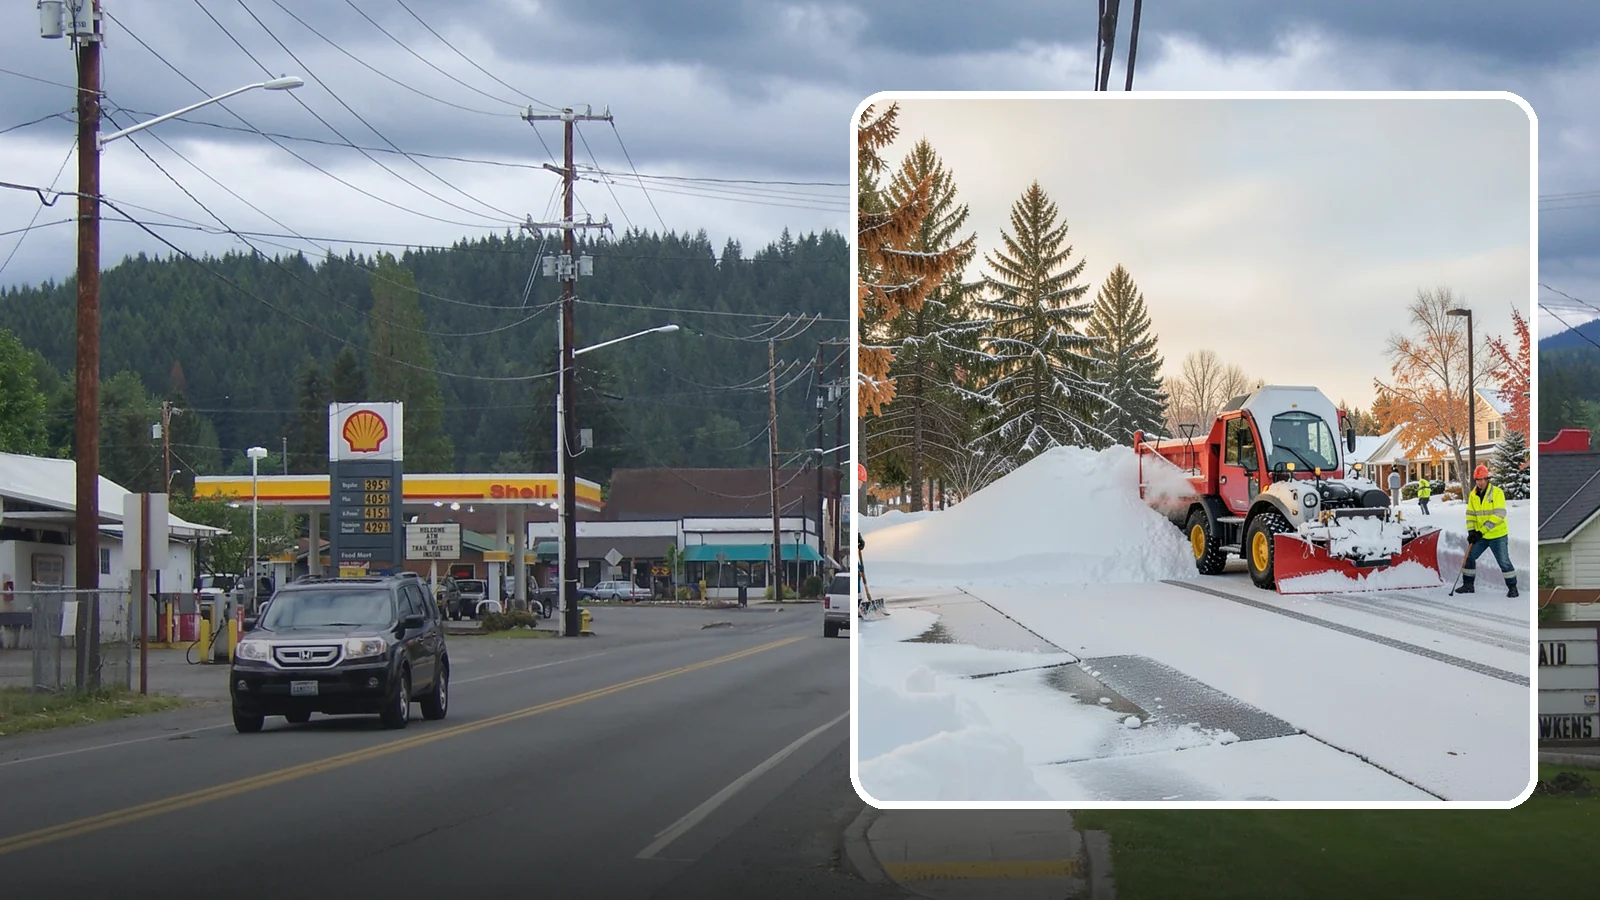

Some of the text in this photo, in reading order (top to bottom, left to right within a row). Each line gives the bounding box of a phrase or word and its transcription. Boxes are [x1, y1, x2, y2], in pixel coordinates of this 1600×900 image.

[366, 480, 383, 490] 395
[490, 484, 547, 499] Shell
[366, 494, 383, 504] 405
[366, 508, 383, 518] 415
[366, 522, 383, 532] 429
[1538, 642, 1566, 666] AID
